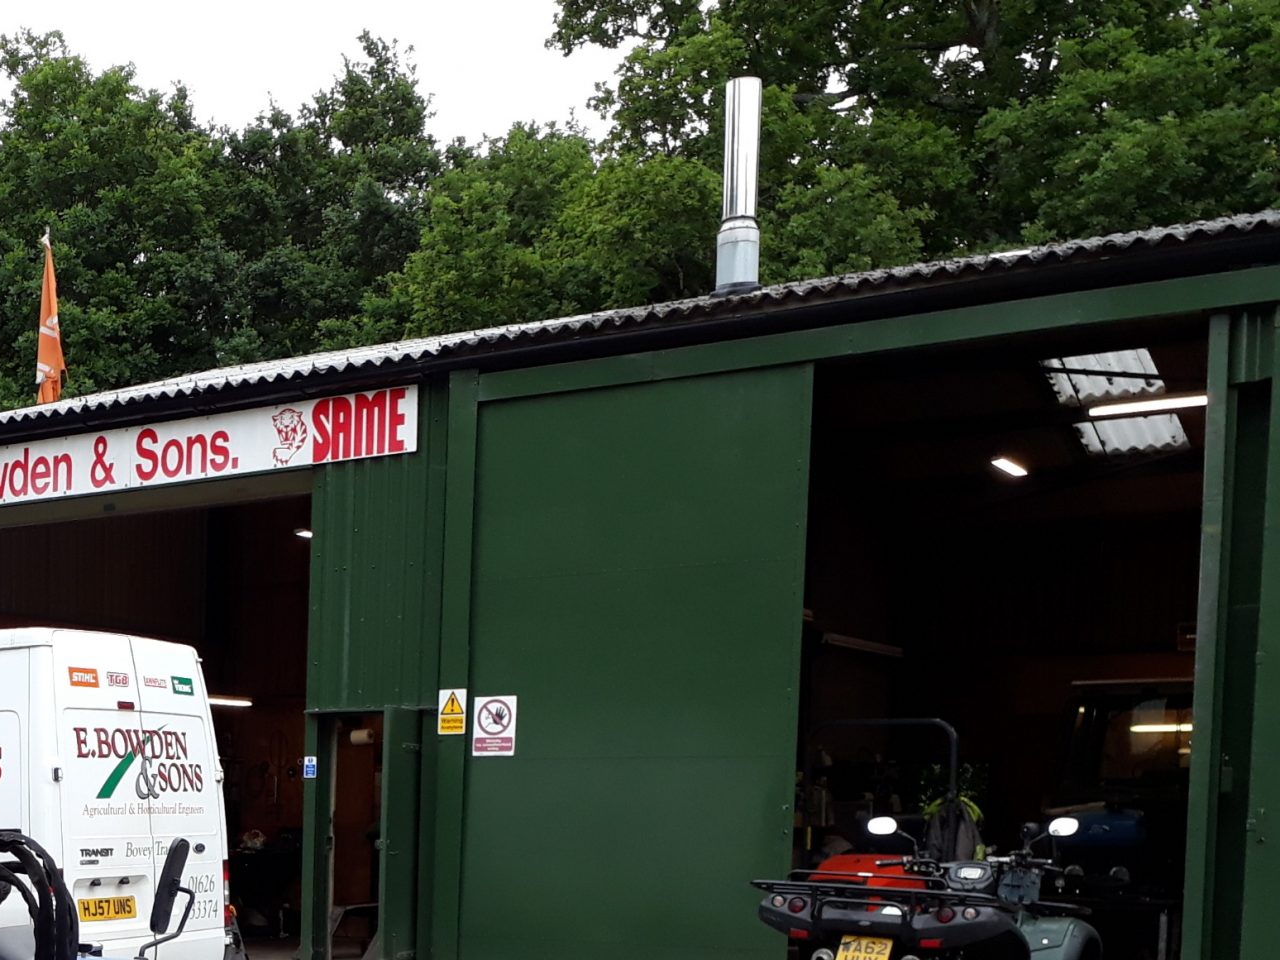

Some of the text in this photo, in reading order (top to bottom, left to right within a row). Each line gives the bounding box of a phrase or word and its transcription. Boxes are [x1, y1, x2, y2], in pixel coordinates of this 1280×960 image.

[312, 388, 406, 464] SAME
[90, 435, 117, 489] &
[135, 427, 239, 482] Sons.
[72, 672, 96, 683] STIHL
[82, 803, 127, 819] Agricultural
[128, 804, 136, 815] &
[80, 848, 114, 858] TRANSIT
[126, 841, 171, 860] Bovey Tra
[82, 899, 133, 918] HJ57 UNS
